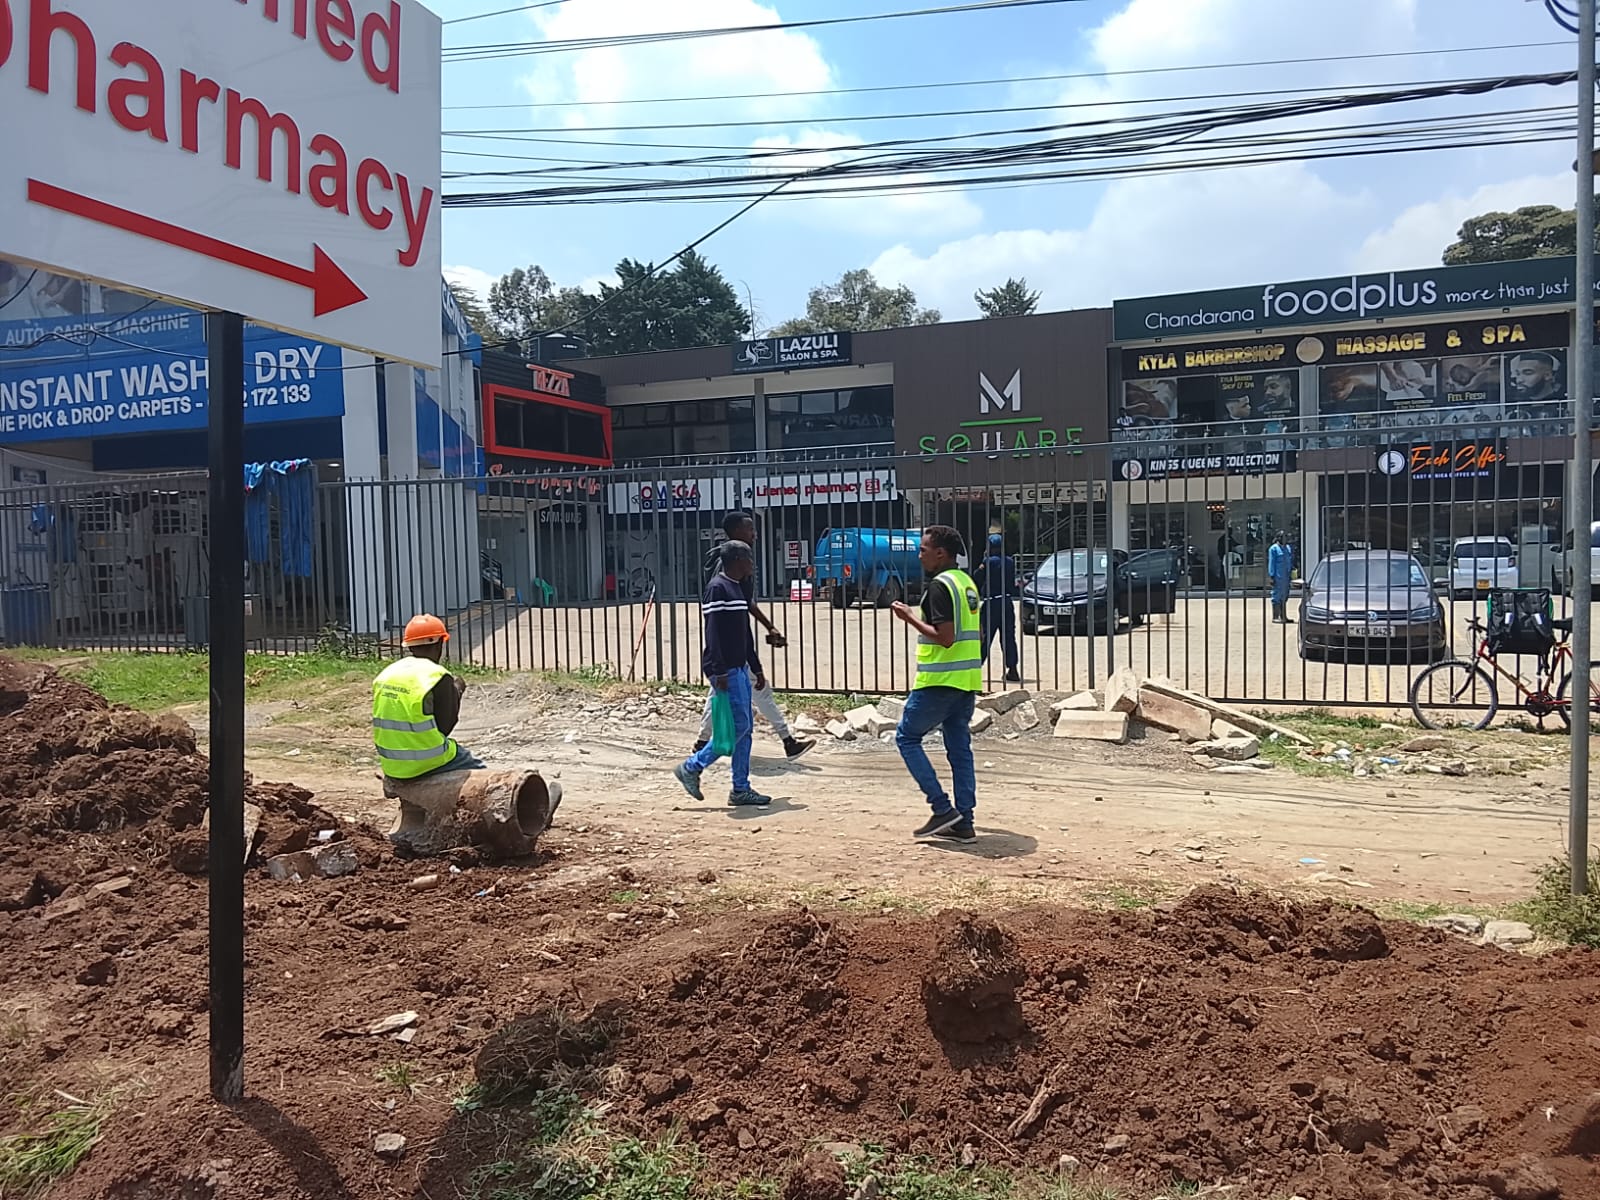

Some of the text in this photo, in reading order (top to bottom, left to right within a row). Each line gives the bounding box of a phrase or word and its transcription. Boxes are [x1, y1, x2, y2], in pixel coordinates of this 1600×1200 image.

[0, 0, 433, 267] harmacy
[1145, 308, 1255, 329] Chandarana
[1262, 271, 1437, 318] foodplus
[1445, 287, 1496, 303] more
[1498, 281, 1535, 299] than
[1537, 277, 1570, 299] just
[6, 328, 45, 345] AUTO
[116, 313, 190, 337] MACHINE
[780, 334, 838, 353] LAZULI
[1336, 324, 1526, 356] MASSAGE & SPA
[120, 359, 209, 397] WASH
[255, 345, 323, 384] DRY
[780, 349, 838, 361] SALON & SPA
[1138, 344, 1285, 371] KYLA BARBERSHOP
[18, 411, 53, 430] PICK
[56, 410, 69, 426] &
[71, 405, 115, 425] DROP
[120, 396, 192, 420] CARPETS
[251, 387, 278, 407] 172
[281, 384, 311, 404] 133
[979, 368, 1021, 414] M
[919, 427, 1083, 463] SQUARE
[643, 499, 698, 510] OTIIANS
